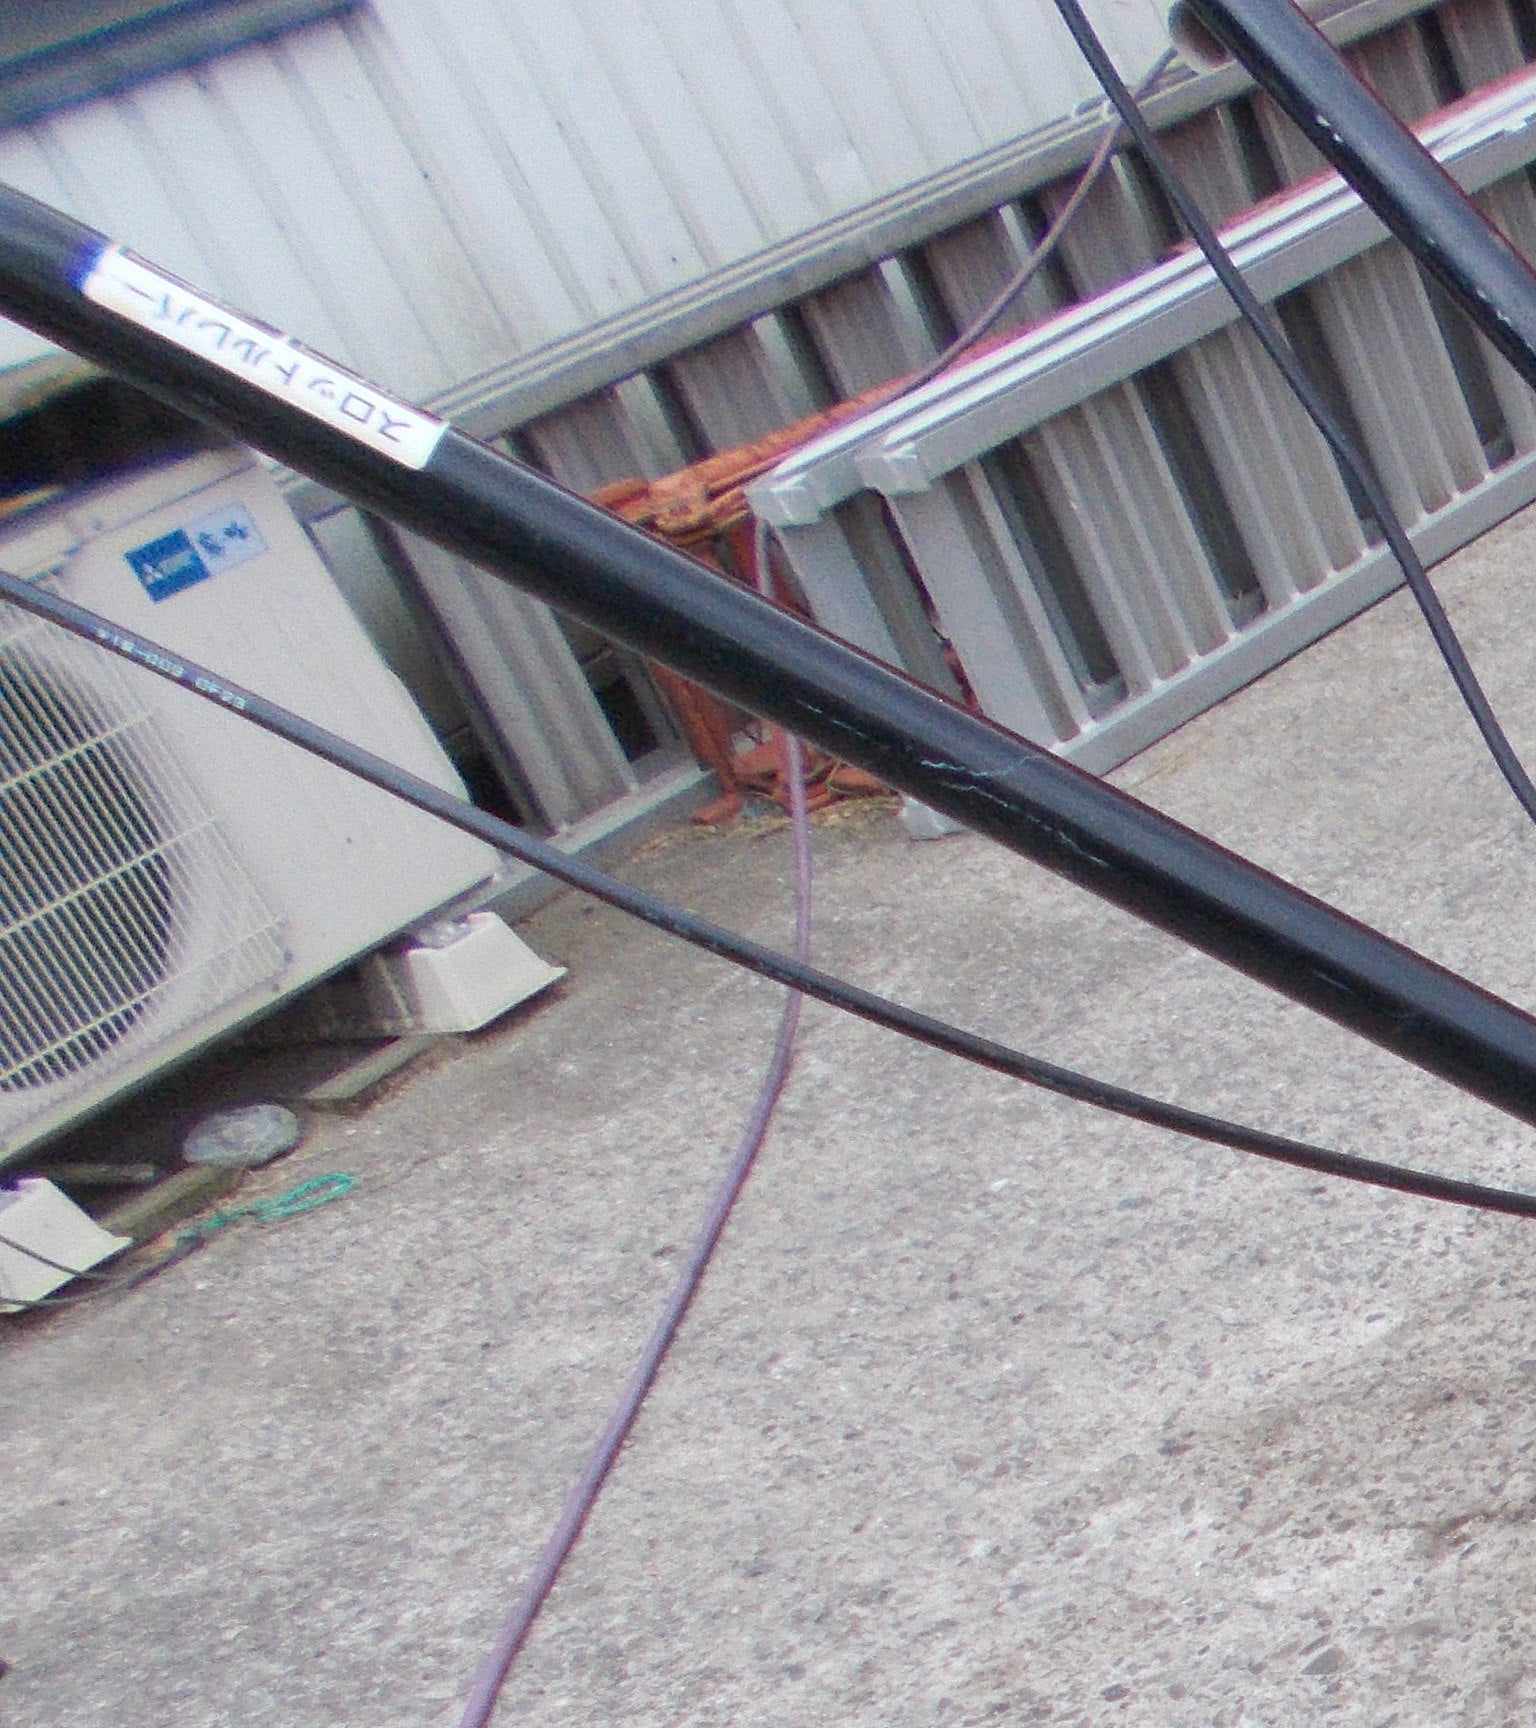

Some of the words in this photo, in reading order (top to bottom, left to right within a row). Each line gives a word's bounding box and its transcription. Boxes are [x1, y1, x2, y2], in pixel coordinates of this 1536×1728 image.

[124, 281, 411, 444] スロットルレバー
